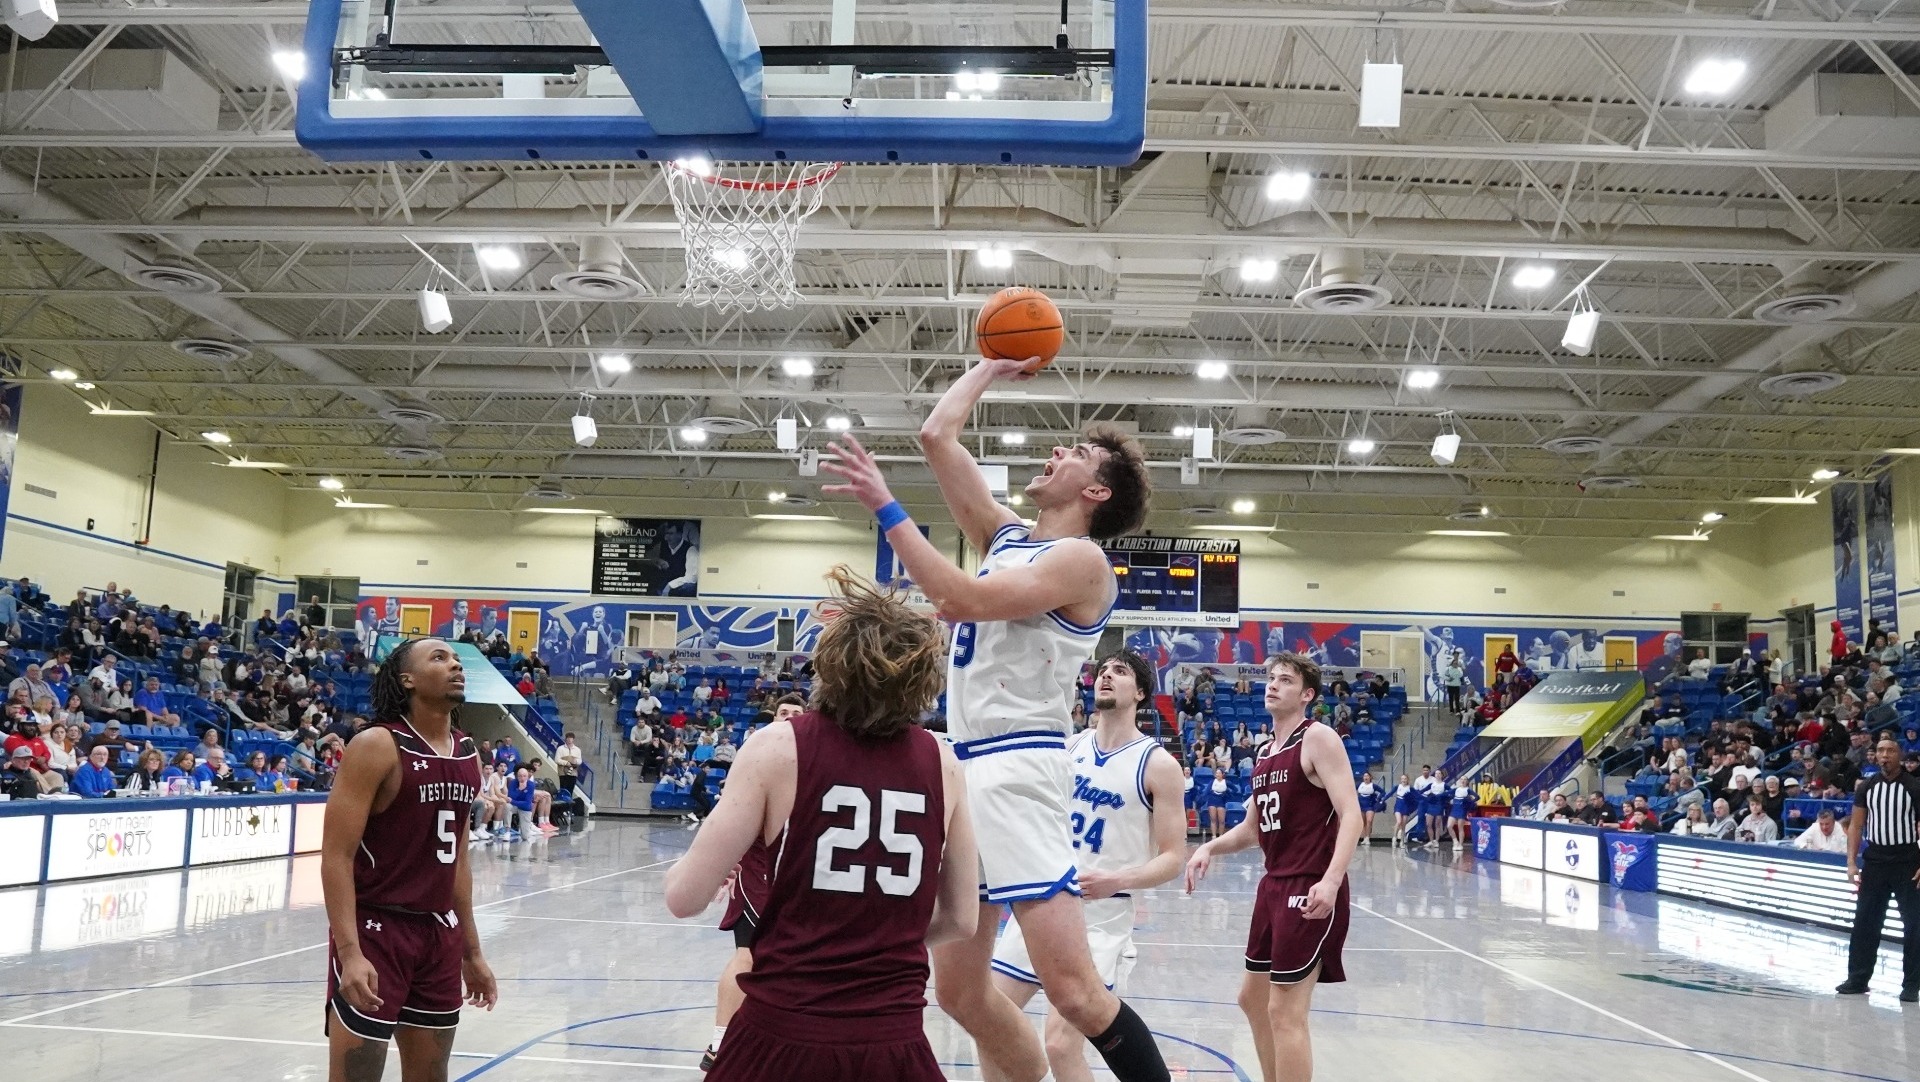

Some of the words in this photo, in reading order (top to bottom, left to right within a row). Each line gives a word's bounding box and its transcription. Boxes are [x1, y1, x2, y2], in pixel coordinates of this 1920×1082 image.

[603, 527, 657, 537] COPELAND
[1116, 538, 1172, 550] CHRISTIAN
[1174, 539, 1238, 553] UNIVERSITY
[1205, 615, 1231, 623] United
[1238, 666, 1267, 675] United
[1538, 682, 1622, 695] Fairfield
[1252, 773, 1267, 790] WEST
[1270, 769, 1288, 784] TEXAS
[419, 782, 445, 803] WEST
[447, 783, 474, 803] TEXAS
[1256, 790, 1282, 833] 32
[88, 817, 112, 832] PLAY
[115, 816, 124, 830] IT
[126, 815, 152, 829] AGAIN
[1070, 812, 1107, 854] 24
[86, 830, 152, 860] SPORTS
[436, 809, 457, 864] 5
[812, 784, 926, 897] 25
